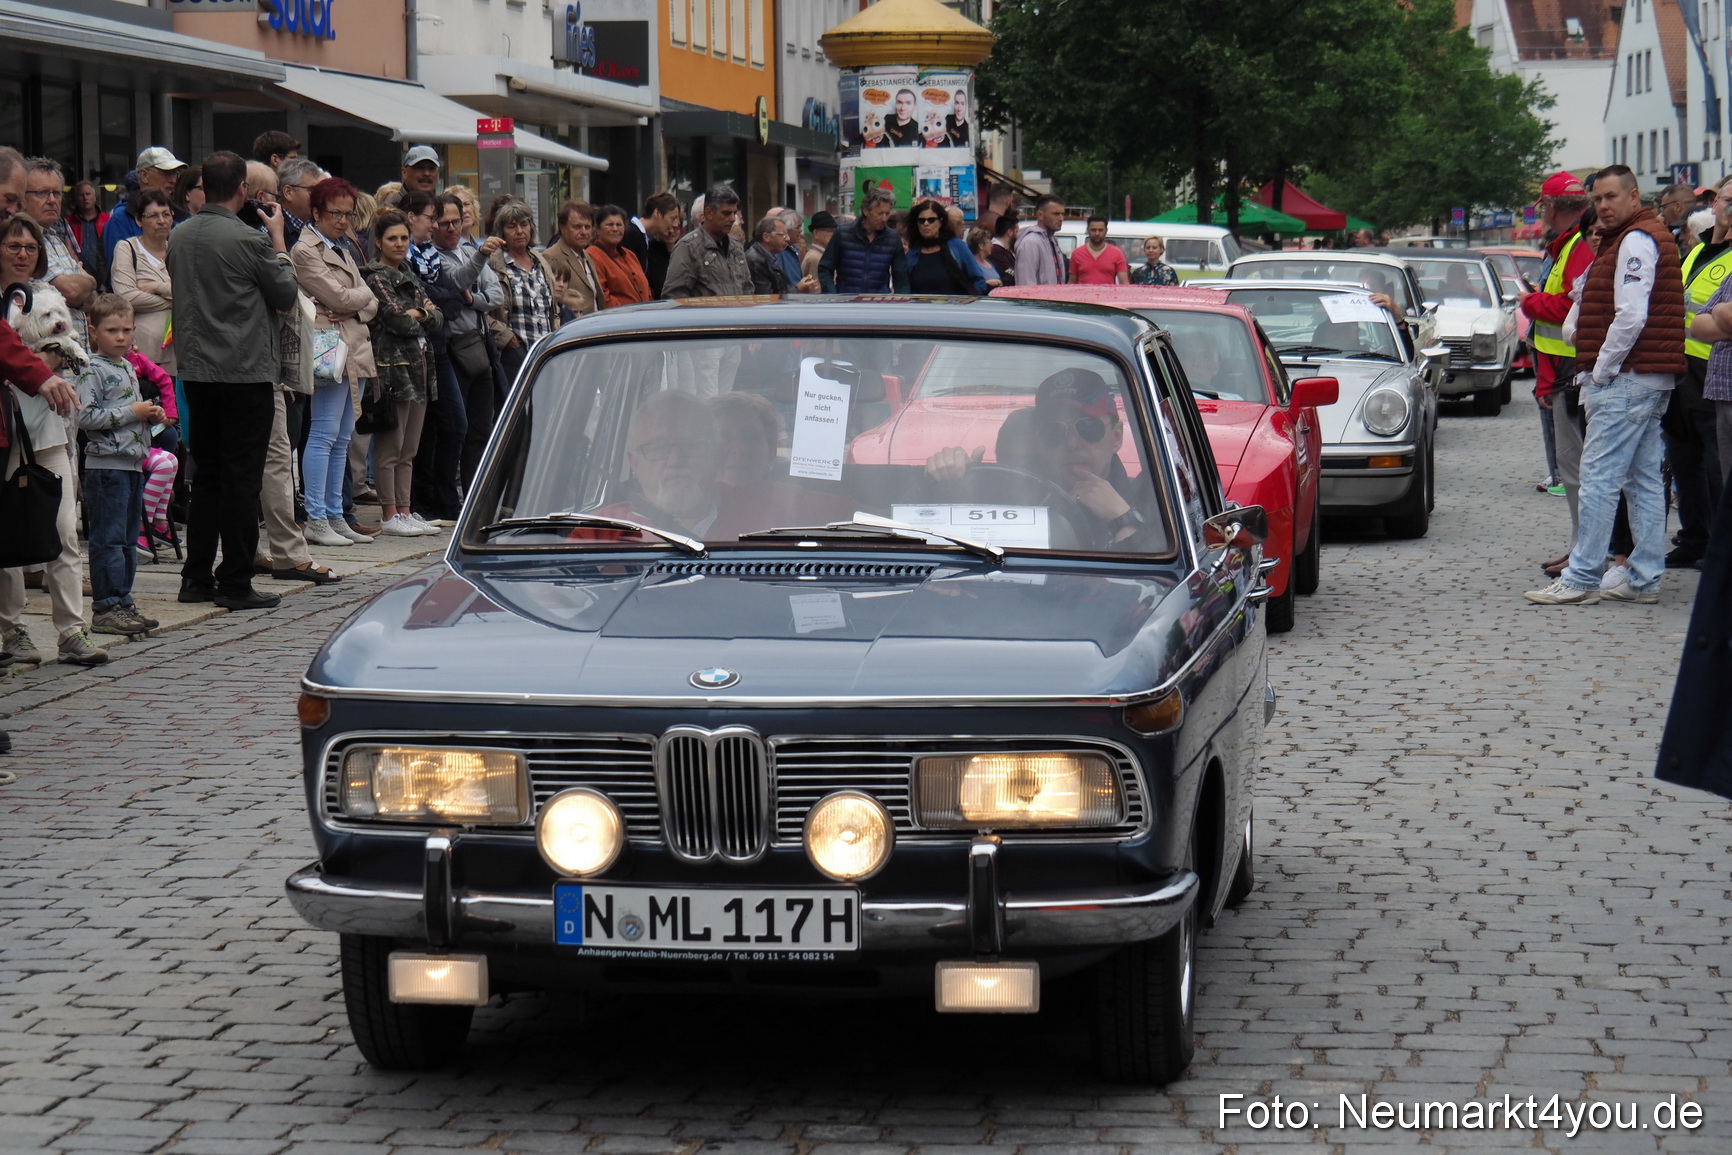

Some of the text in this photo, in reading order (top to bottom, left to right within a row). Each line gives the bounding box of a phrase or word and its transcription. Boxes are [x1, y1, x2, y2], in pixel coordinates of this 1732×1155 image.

[804, 391, 844, 403] Nur gucken,
[814, 404, 831, 412] nicht
[804, 415, 835, 424] anfassen
[968, 510, 1018, 520] 516
[585, 894, 613, 939] N
[649, 895, 711, 941] ML
[564, 921, 575, 934] D
[578, 948, 723, 961] Anhaengerverleih-Nuernberg.de
[734, 952, 750, 960] Tel.
